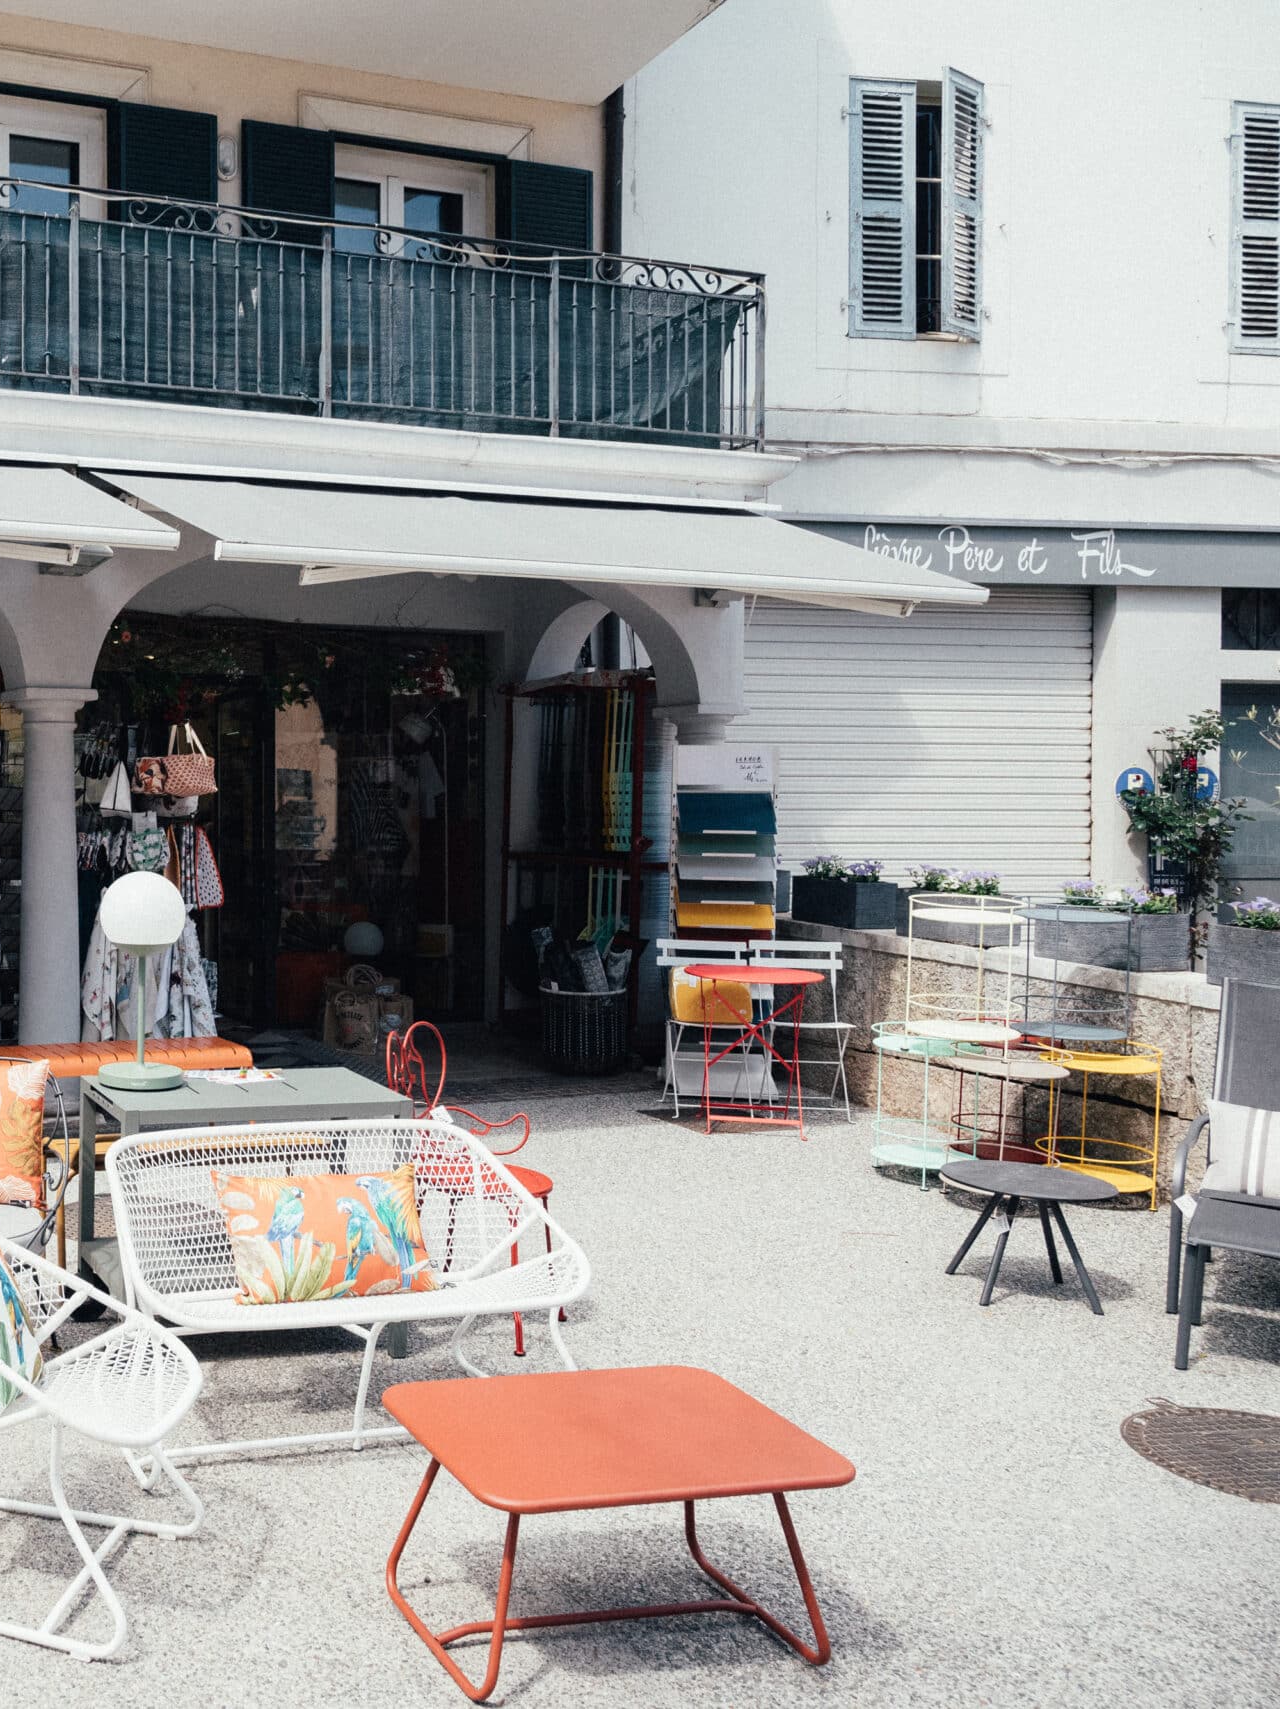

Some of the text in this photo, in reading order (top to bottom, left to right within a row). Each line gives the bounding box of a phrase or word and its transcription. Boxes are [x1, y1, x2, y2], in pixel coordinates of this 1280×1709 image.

[938, 525, 1006, 572] Père
[1017, 537, 1048, 575] et
[1070, 528, 1157, 579] Fils
